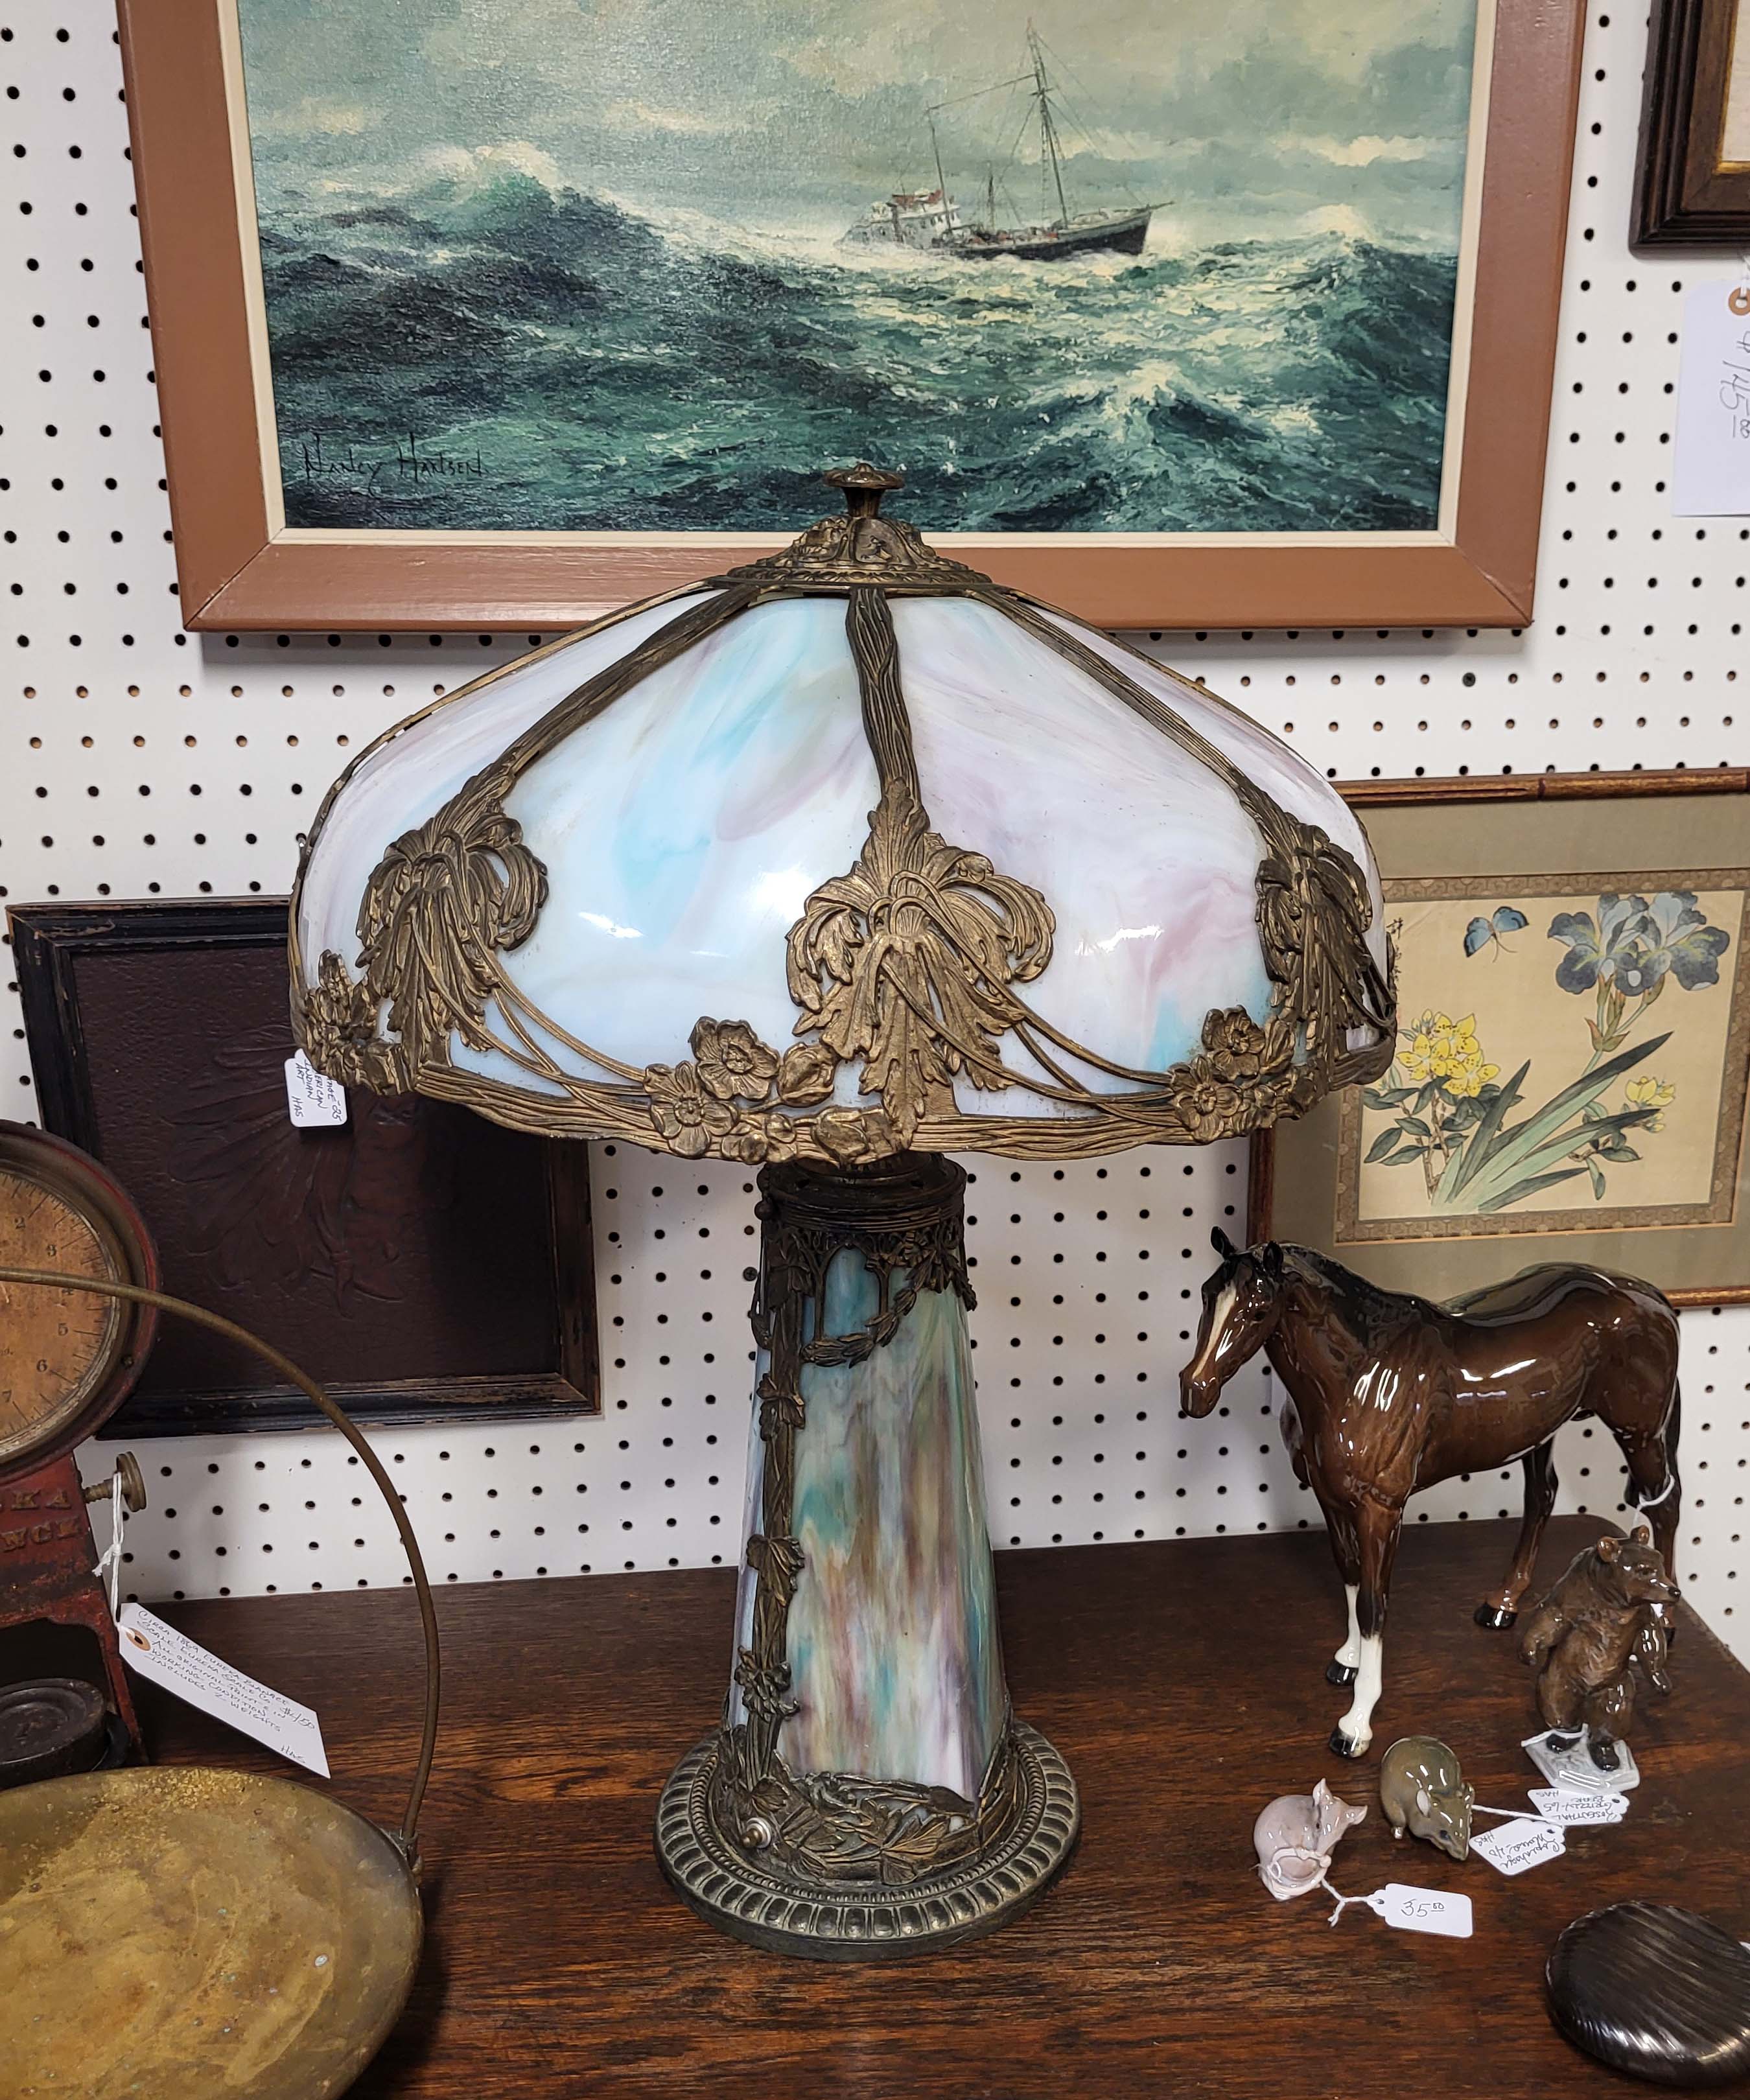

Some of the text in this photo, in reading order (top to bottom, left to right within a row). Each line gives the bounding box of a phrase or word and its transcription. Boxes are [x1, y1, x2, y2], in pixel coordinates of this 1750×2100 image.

[296, 1062, 305, 1084] ART
[305, 1059, 317, 1100] INDIAN
[14, 1217, 26, 1230] 2
[46, 1244, 57, 1257] 3
[58, 1322, 69, 1336] 5
[36, 1359, 48, 1373] 6
[3, 1389, 12, 1403] 7
[152, 1648, 204, 1681] WORKING
